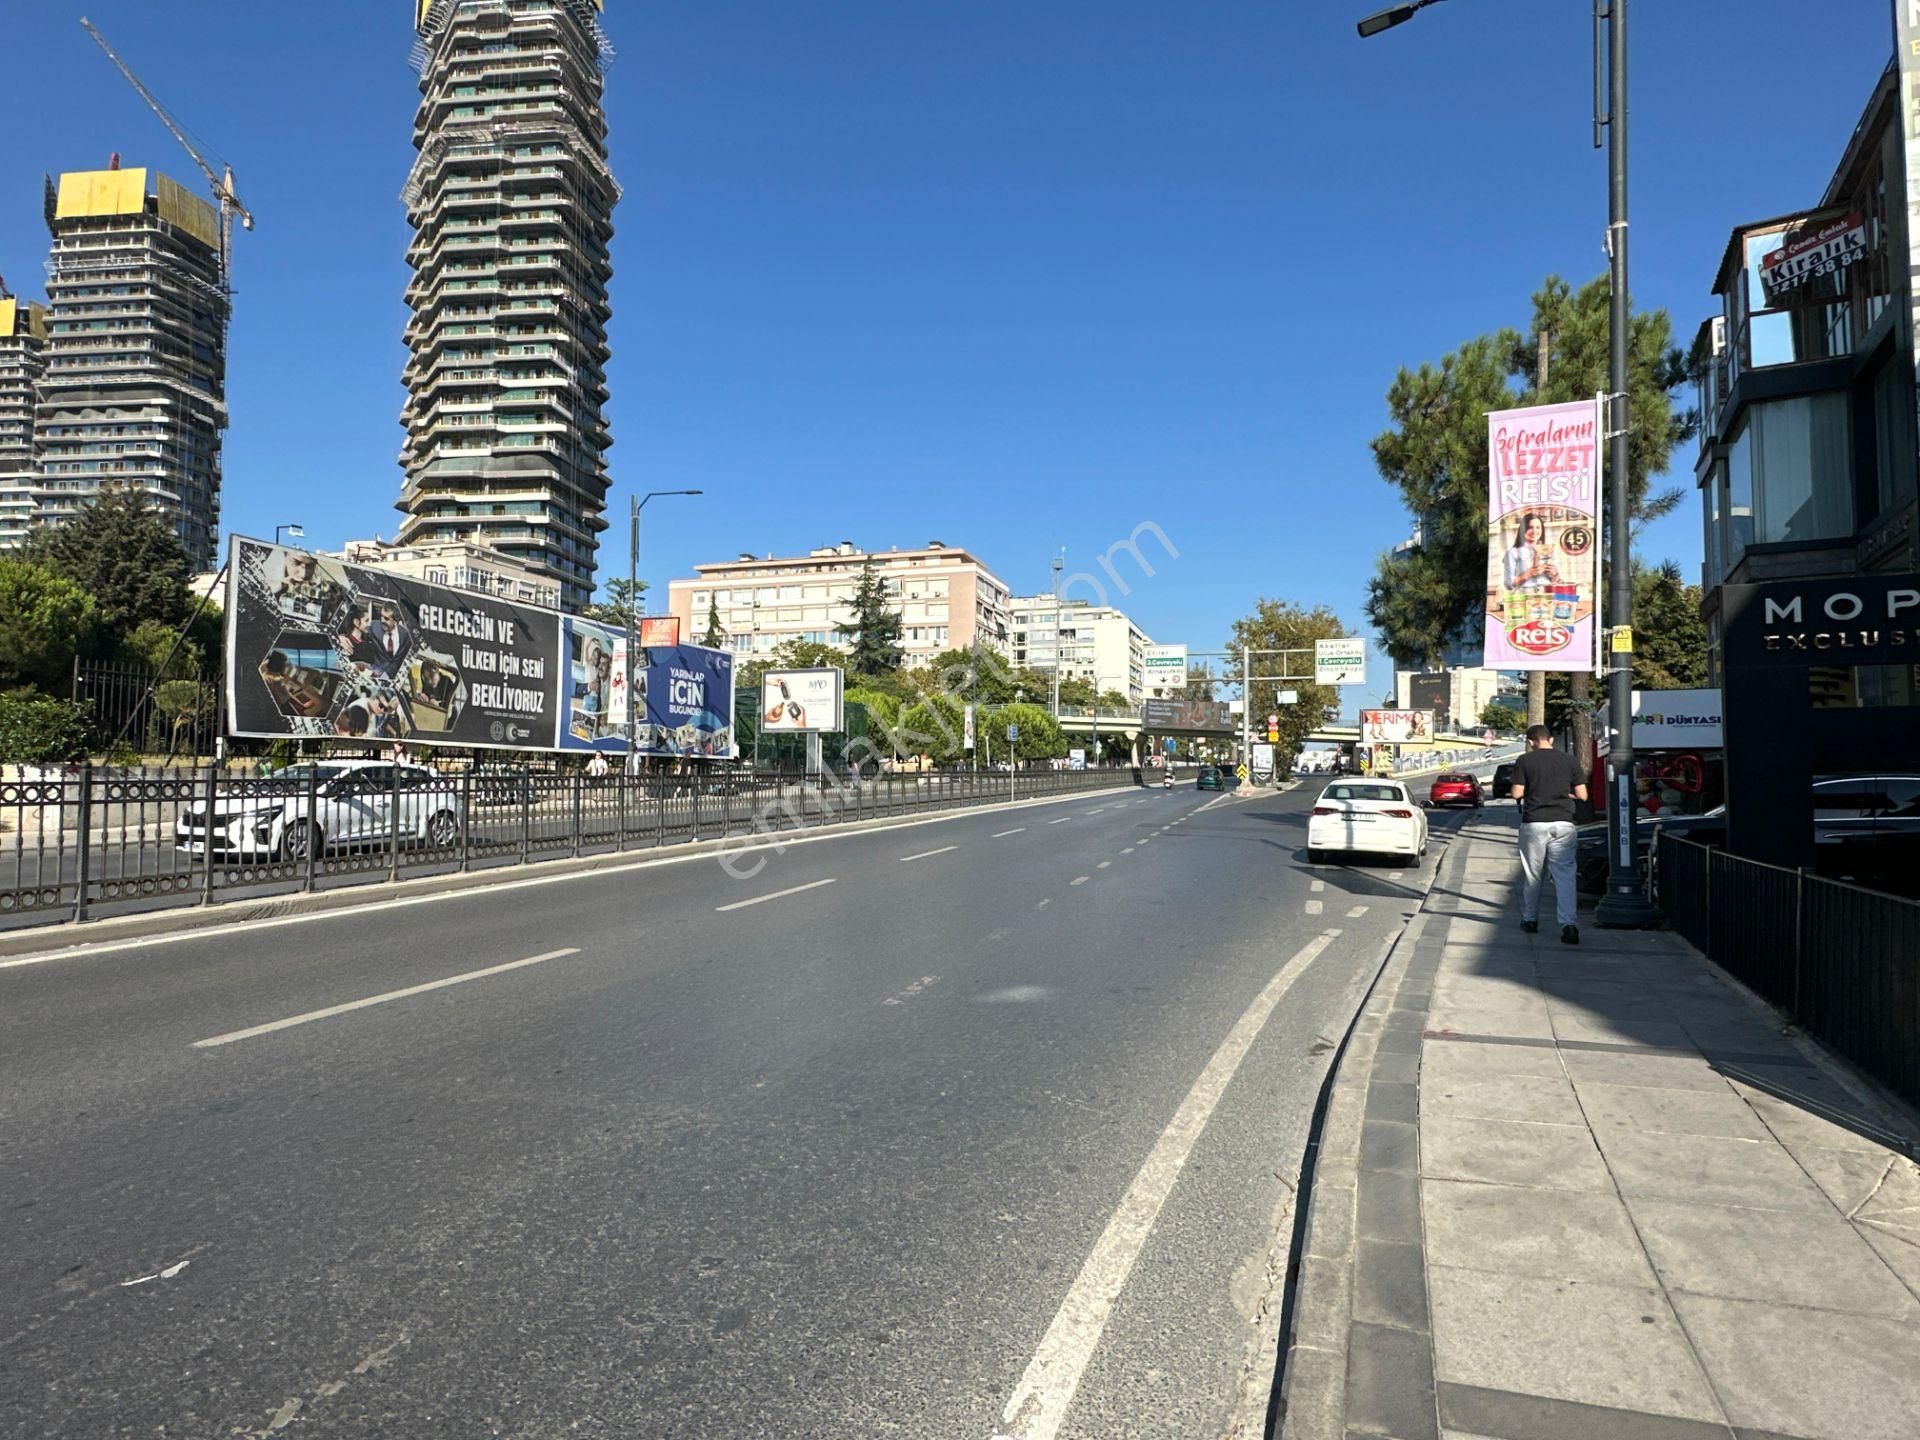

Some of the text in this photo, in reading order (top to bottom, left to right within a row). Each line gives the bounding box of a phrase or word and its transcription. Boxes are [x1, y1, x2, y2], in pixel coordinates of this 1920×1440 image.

[1818, 220, 1848, 240] Emlak
[1770, 233, 1860, 284] Kiralık
[1814, 259, 1836, 277] 38
[1841, 249, 1864, 266] 84
[1496, 419, 1593, 453] Sofraların
[1502, 444, 1594, 476] LEZZET
[1501, 468, 1590, 505] REİS'İ
[1566, 533, 1584, 545] 45
[418, 603, 514, 645] GELECEĞİN VE
[1764, 629, 1920, 651] EXCLUS
[462, 644, 545, 680] ÜLKEN İÇİN SENİ
[669, 666, 705, 682] YARINLAR
[471, 682, 545, 713] BEKLİYORUZ
[1667, 714, 1721, 725] DÜNYASI
